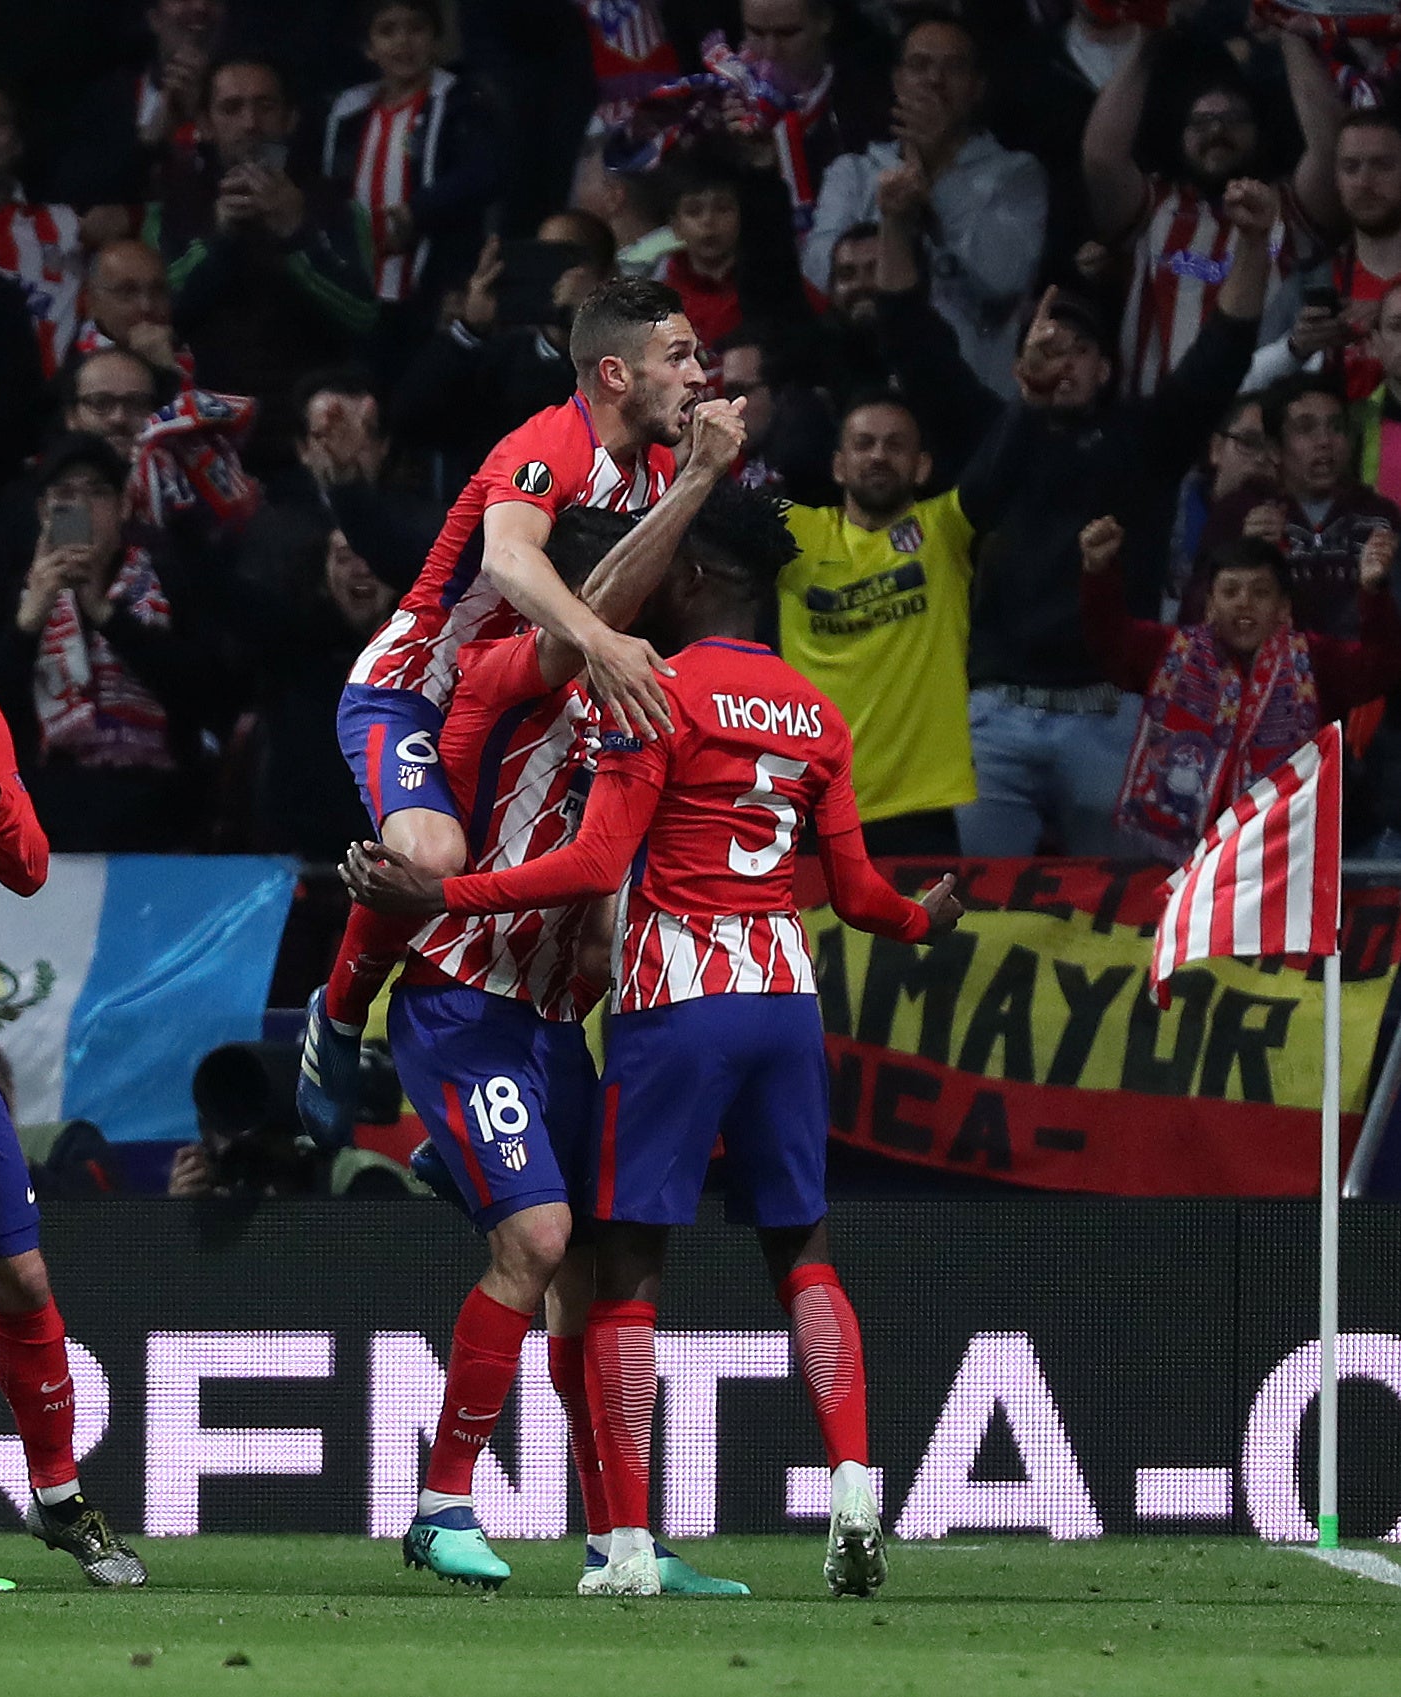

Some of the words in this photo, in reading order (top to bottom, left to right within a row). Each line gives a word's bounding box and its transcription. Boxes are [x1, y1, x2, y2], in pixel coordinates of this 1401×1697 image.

[712, 693, 823, 738] THOMAS
[395, 730, 439, 764] 6
[728, 752, 809, 876] 5
[468, 1076, 530, 1143] 18
